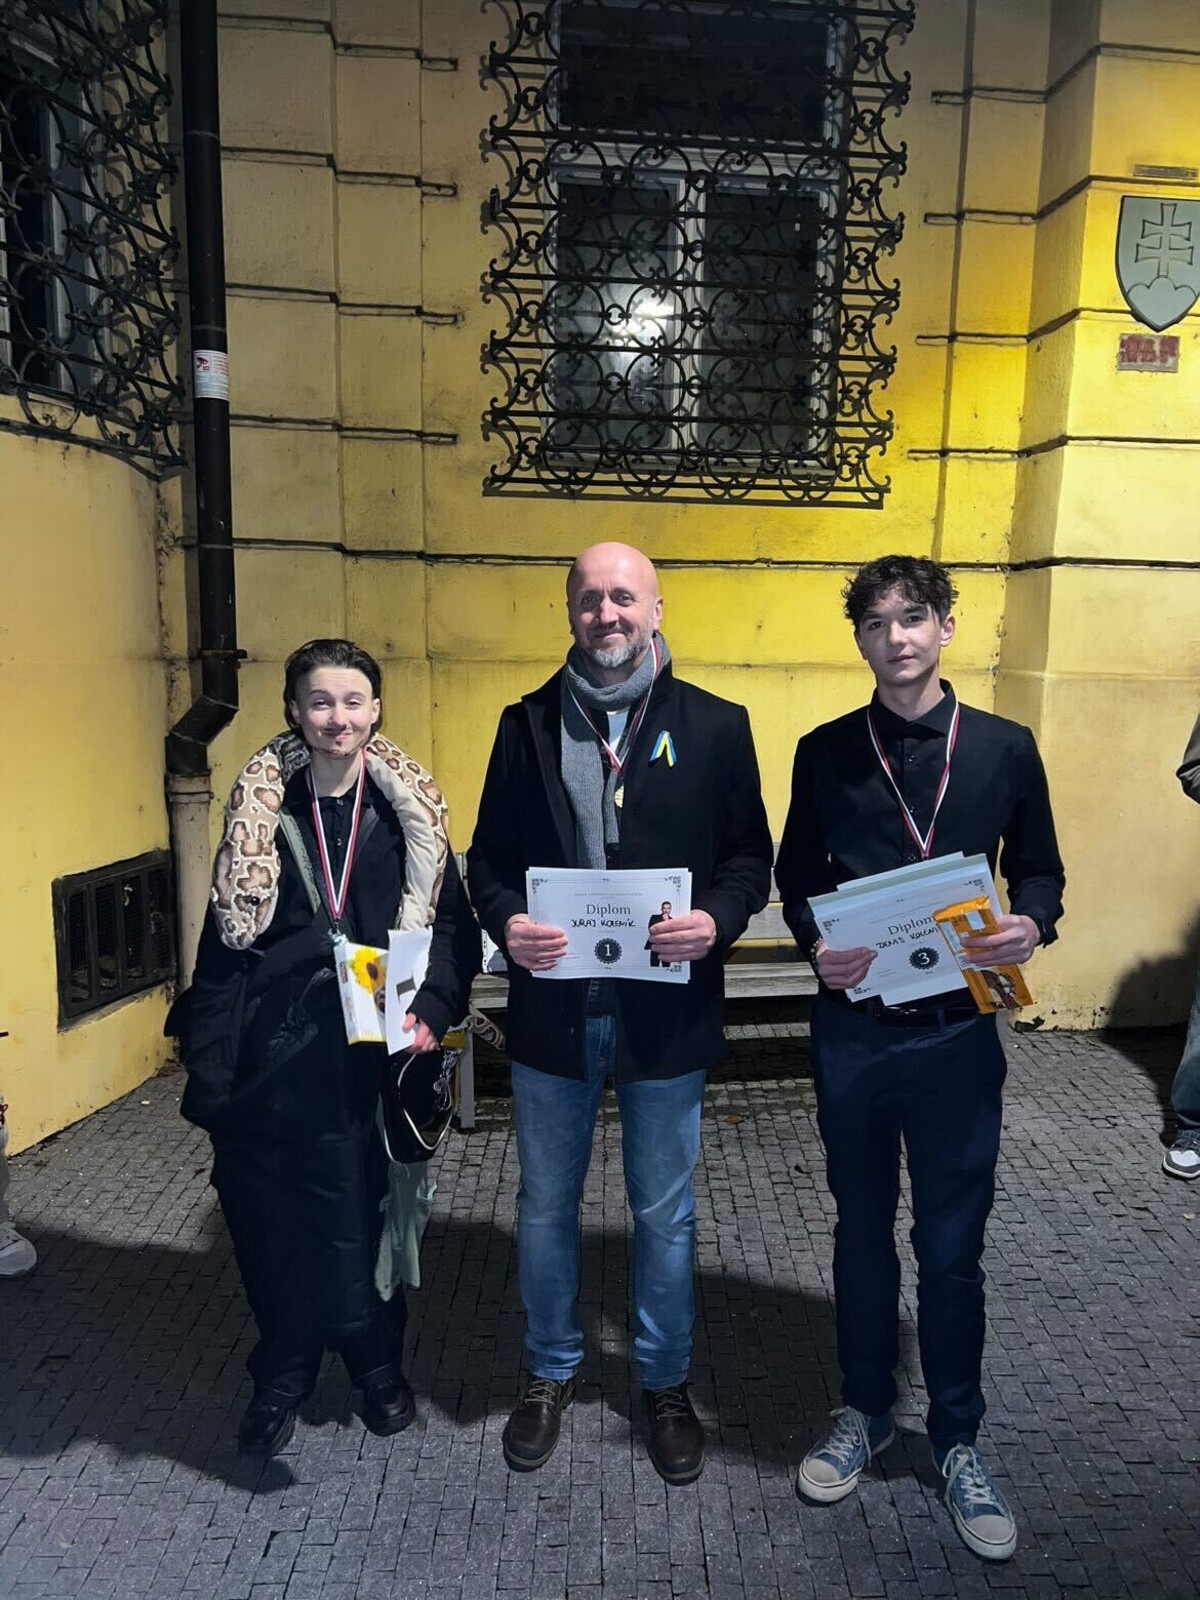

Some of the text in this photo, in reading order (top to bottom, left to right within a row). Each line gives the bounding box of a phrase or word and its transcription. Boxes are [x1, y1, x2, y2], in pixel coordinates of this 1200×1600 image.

[586, 904, 631, 918] Diplom
[605, 944, 611, 957] 1
[919, 952, 930, 965] 3
